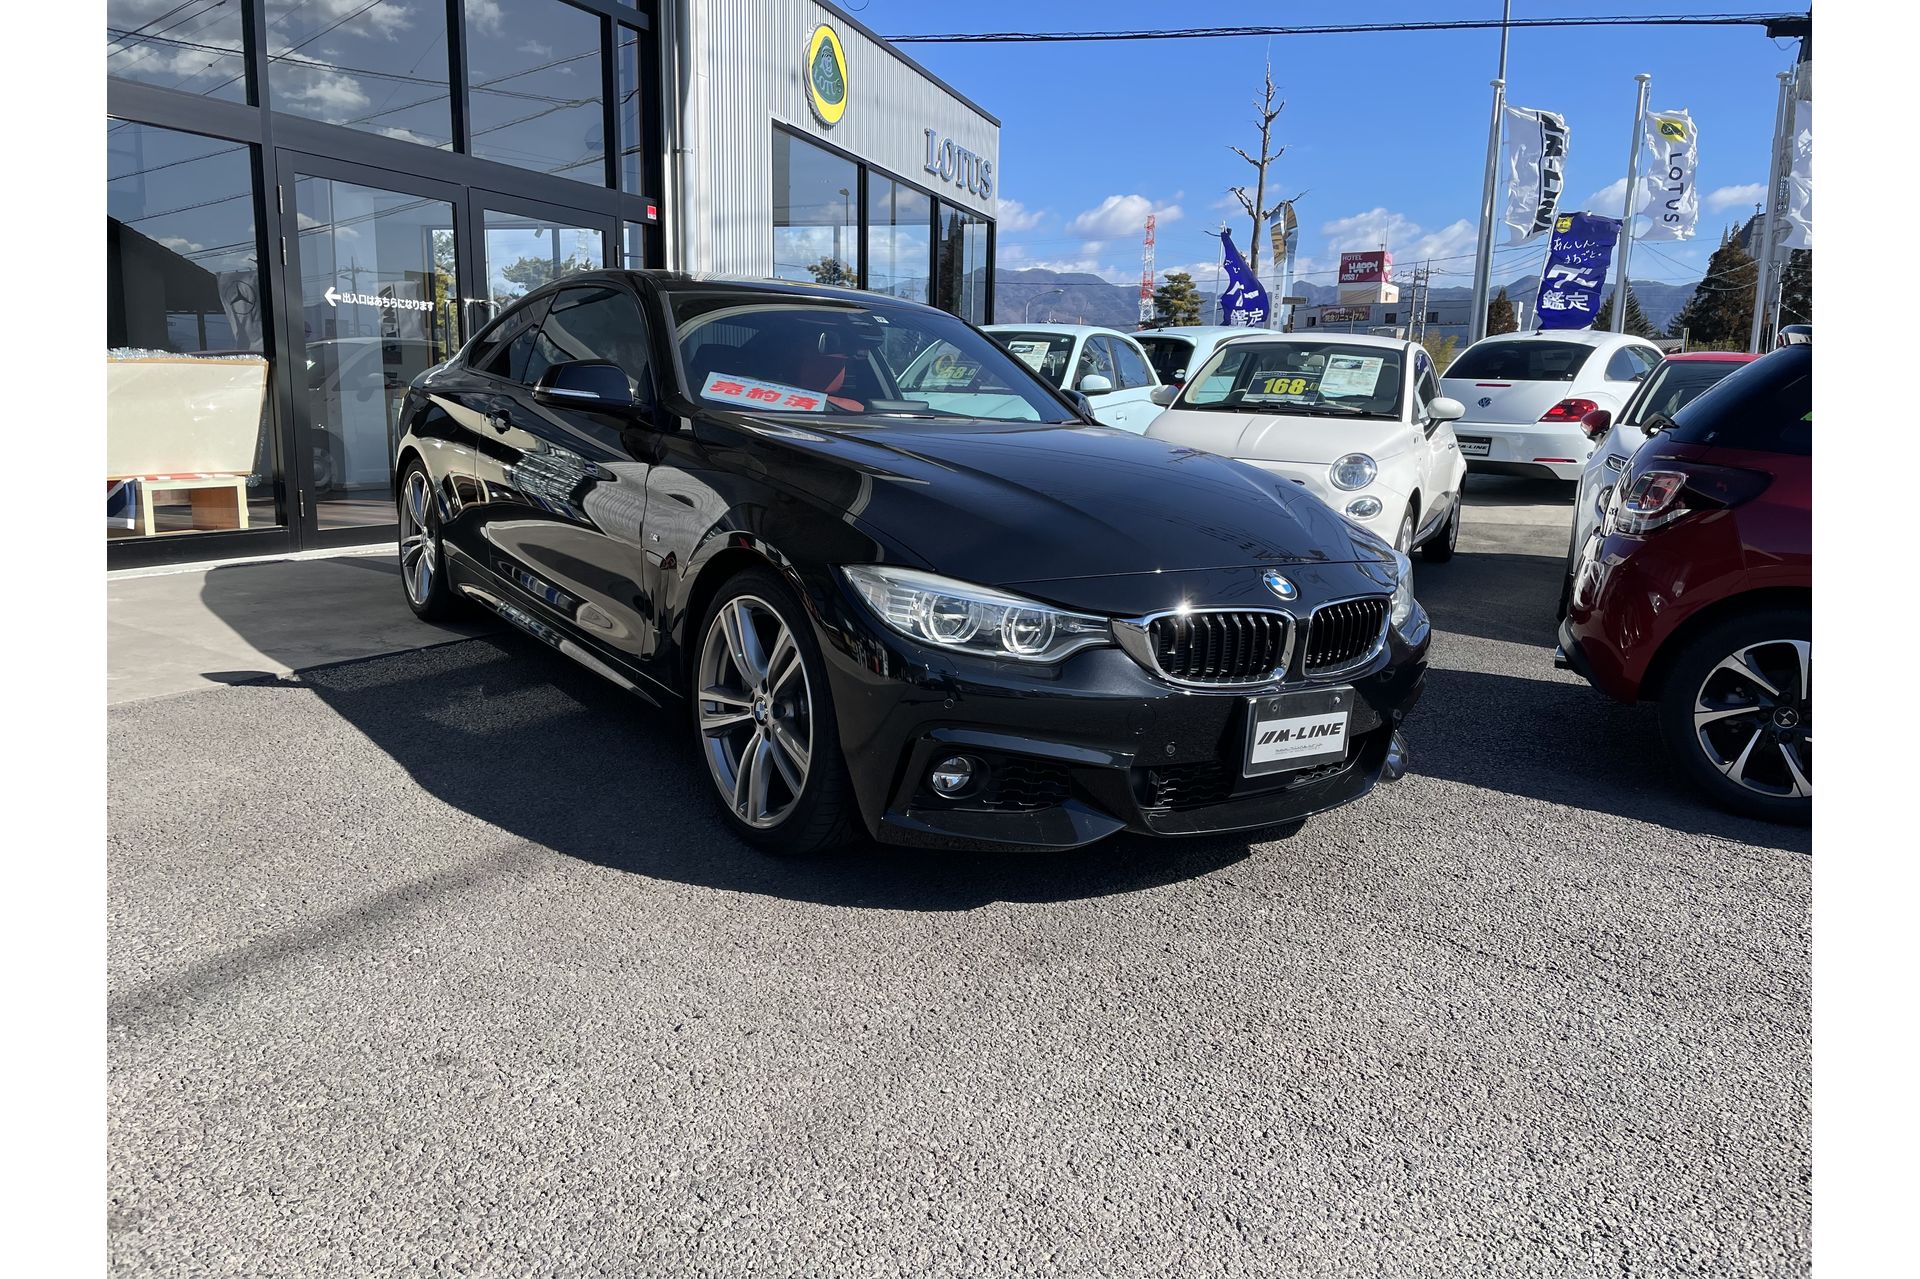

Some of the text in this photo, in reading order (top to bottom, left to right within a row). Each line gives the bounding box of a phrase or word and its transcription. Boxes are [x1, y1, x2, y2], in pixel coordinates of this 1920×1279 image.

[924, 128, 993, 200] LOTUS
[1663, 152, 1684, 223] LOTUS
[1348, 260, 1379, 274] HAPPY
[342, 291, 435, 312] 出入口はあちらになります
[1541, 289, 1591, 312] 鑑定
[1230, 308, 1264, 328] 鑑定
[709, 380, 820, 411] 売約済
